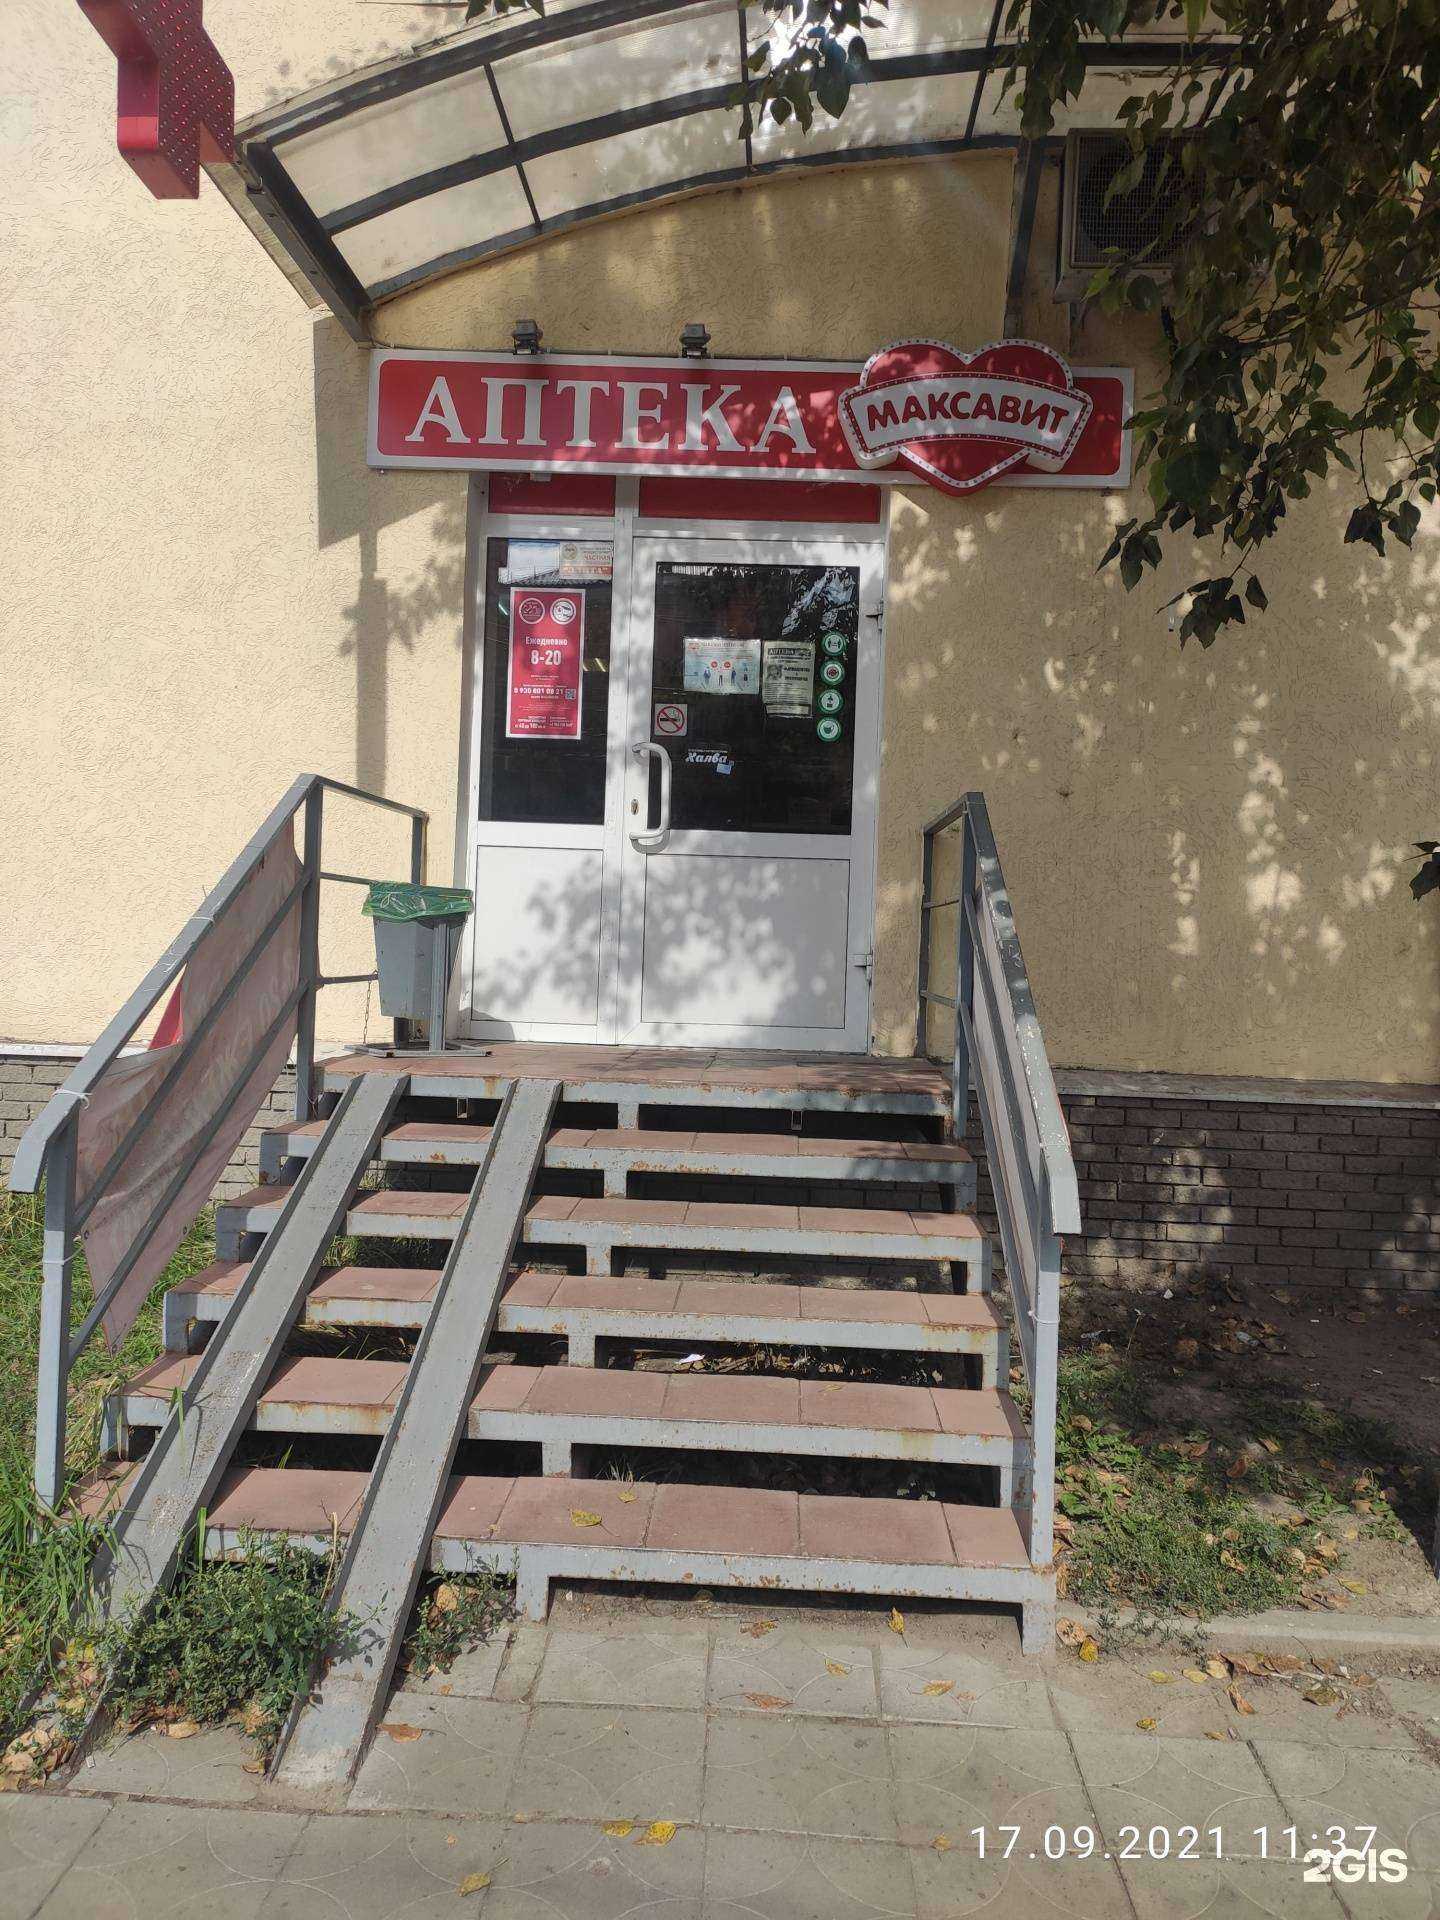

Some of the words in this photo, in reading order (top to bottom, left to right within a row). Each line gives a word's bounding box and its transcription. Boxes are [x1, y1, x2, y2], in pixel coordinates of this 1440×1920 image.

[405, 375, 817, 454] АПТЕКА
[866, 390, 1070, 436] МАКСАВИТ
[525, 636, 568, 647] Ежедневно
[530, 650, 562, 666] 8-20
[685, 752, 728, 764] Халва
